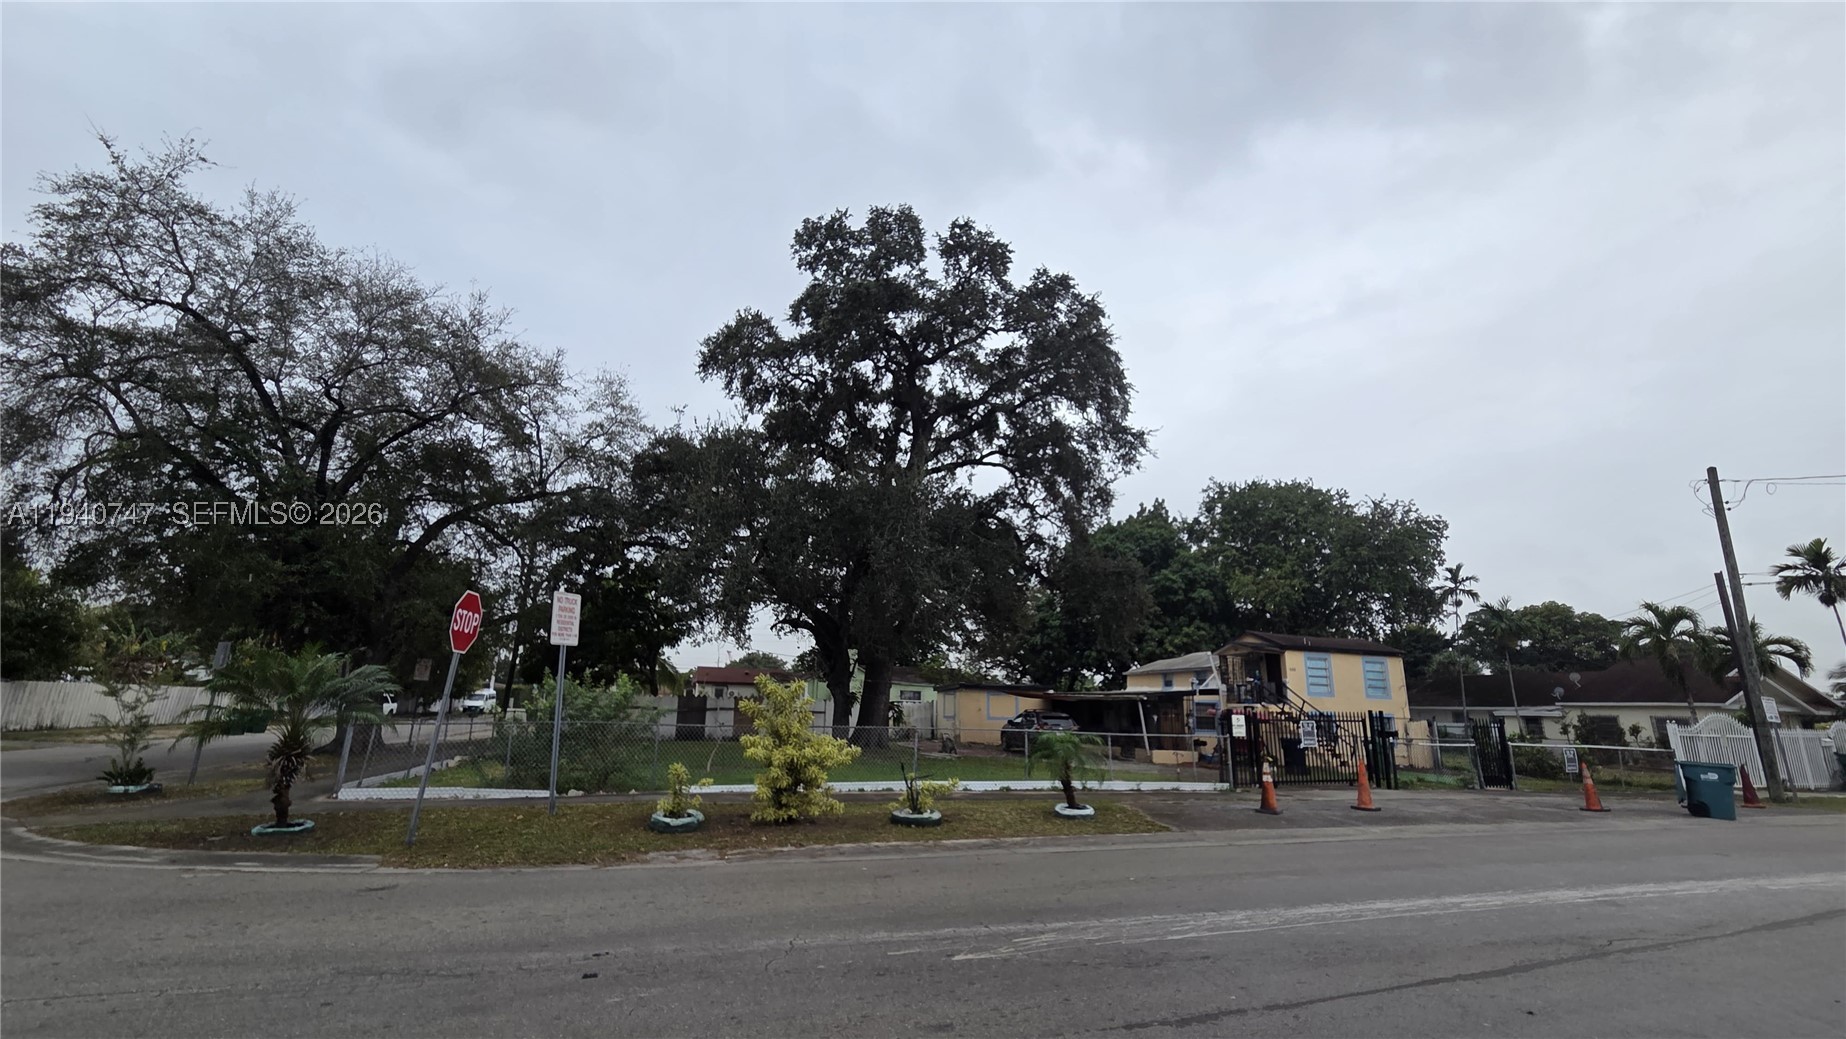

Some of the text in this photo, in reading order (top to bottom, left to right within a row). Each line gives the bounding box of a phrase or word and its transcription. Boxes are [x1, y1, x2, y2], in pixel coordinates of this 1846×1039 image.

[556, 596, 578, 606] NO TRUCK
[558, 605, 576, 614] PARKING
[453, 608, 480, 634] STOP
